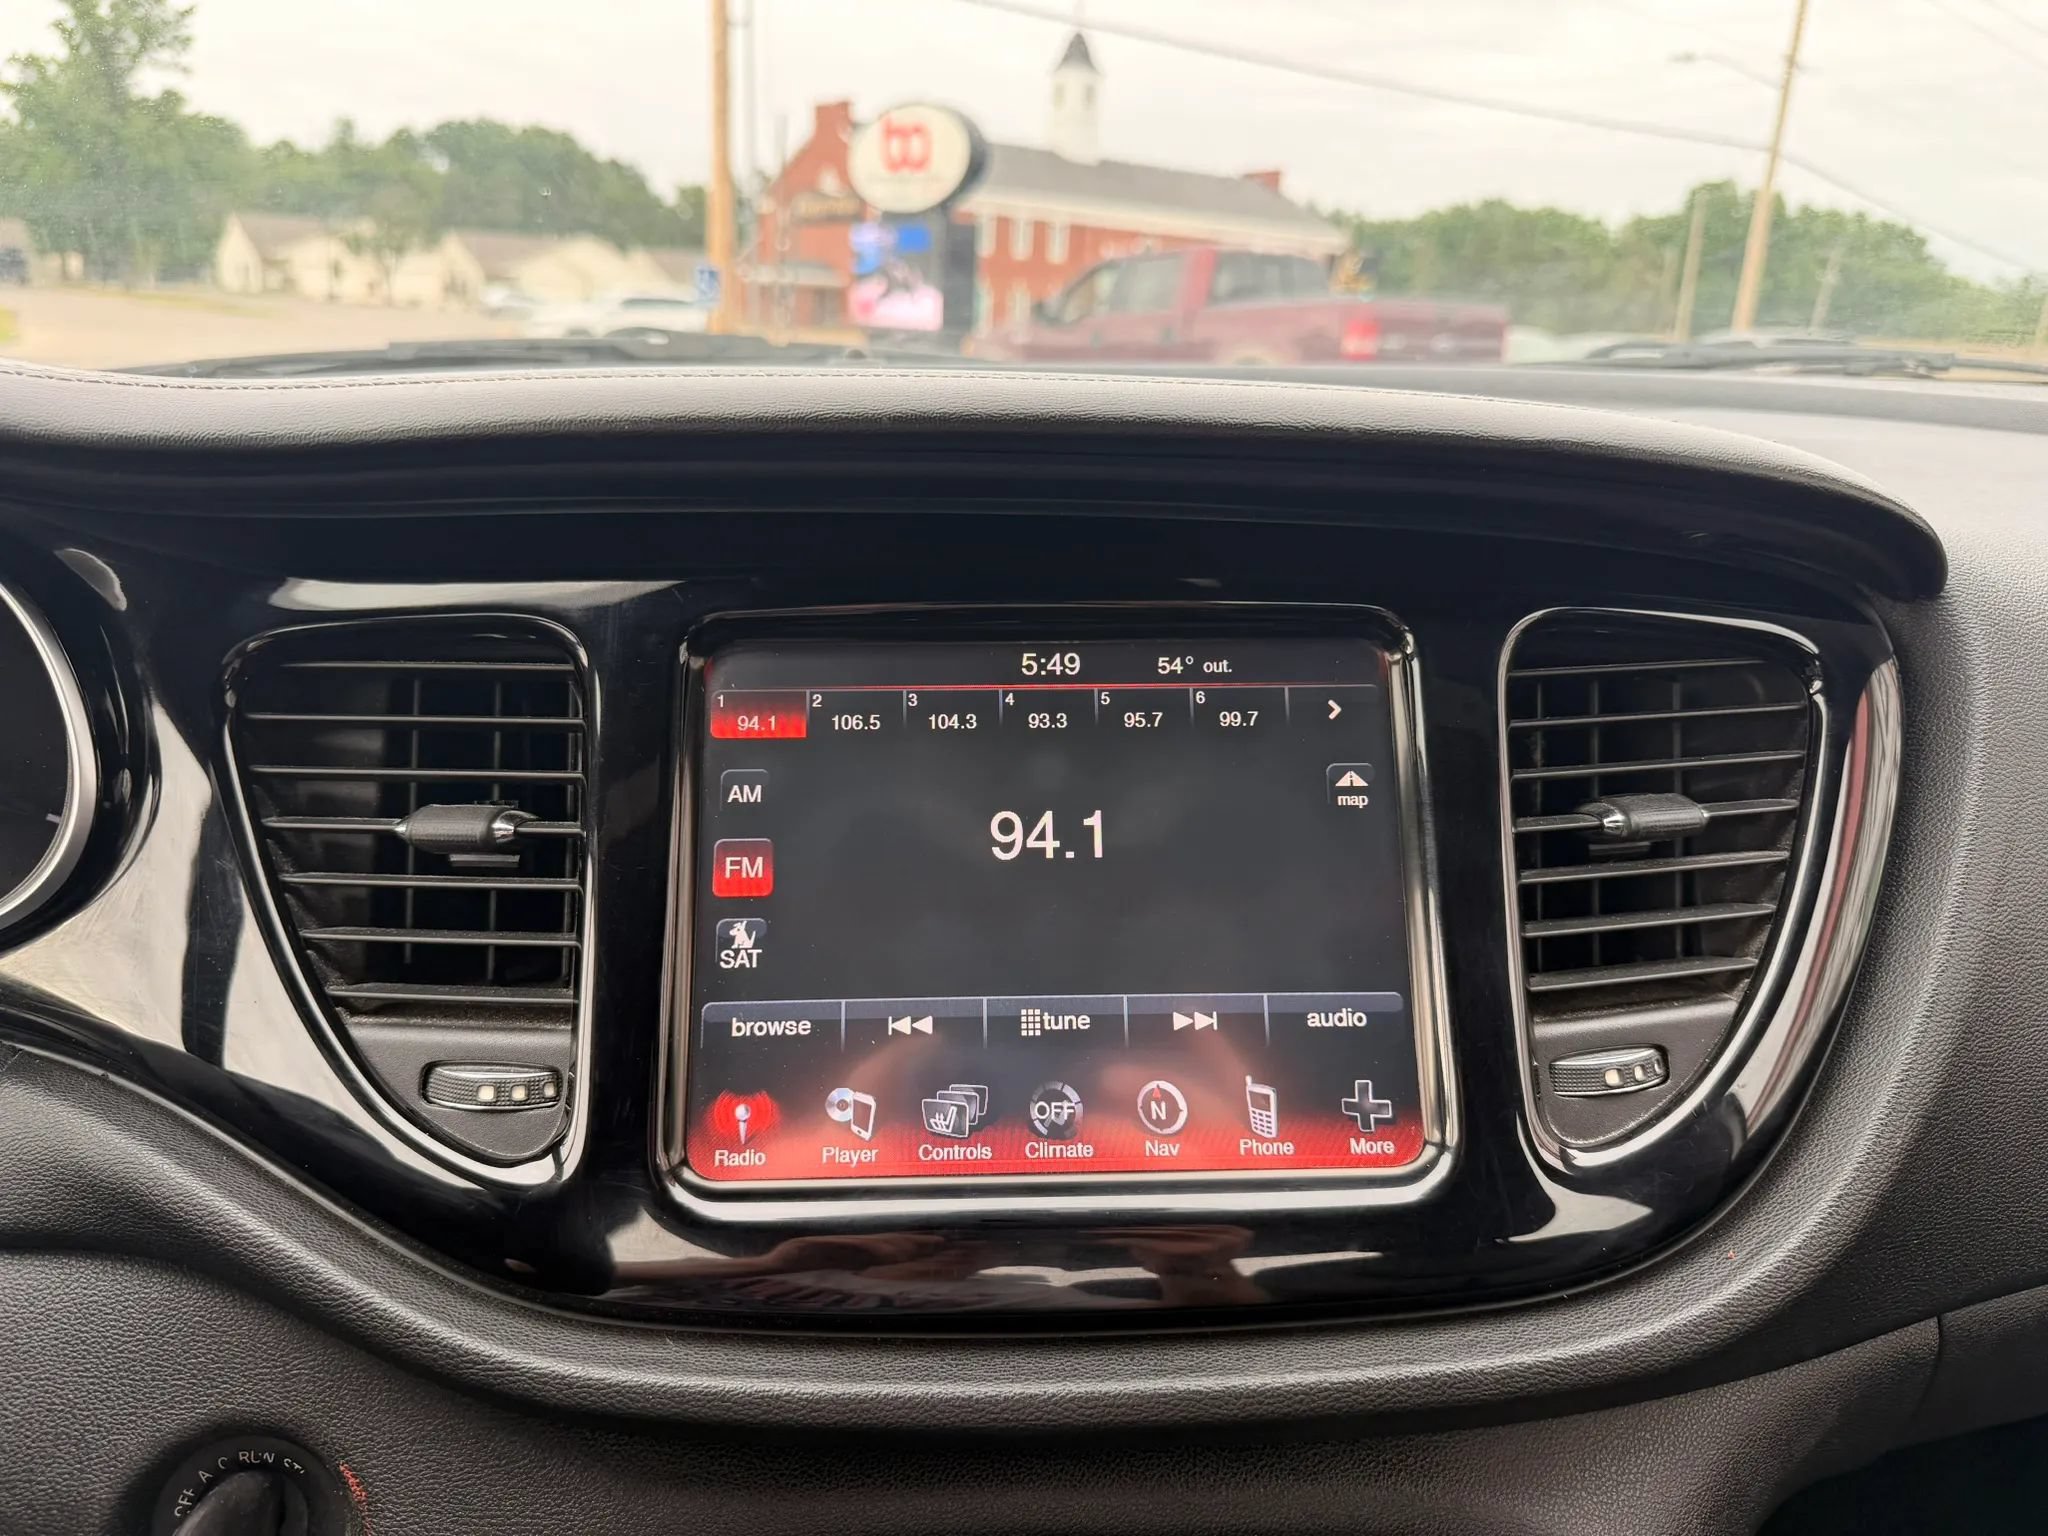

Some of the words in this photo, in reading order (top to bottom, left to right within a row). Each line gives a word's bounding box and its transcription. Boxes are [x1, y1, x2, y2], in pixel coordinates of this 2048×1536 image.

[1021, 652, 1081, 677] 5:49
[1157, 655, 1194, 675] 54°
[1203, 659, 1233, 673] out.
[717, 694, 724, 708] 1
[812, 693, 822, 708] 2
[908, 693, 918, 707] 3
[1004, 692, 1015, 706] 4
[1100, 691, 1111, 705] 5
[1195, 690, 1206, 704] 6
[737, 715, 776, 731] 94.1
[831, 714, 881, 731] 106.5
[928, 713, 977, 730] 104.3
[1028, 712, 1068, 729] 93.3
[1123, 711, 1163, 728] 95.7
[1219, 710, 1259, 727] 99.7
[727, 784, 762, 803] AM
[1337, 795, 1369, 809] map
[990, 809, 1103, 861] 94.1
[725, 856, 763, 878] FM
[719, 950, 763, 969] SAT
[1042, 1011, 1091, 1030] tune
[1307, 1007, 1367, 1027] audio
[731, 1017, 812, 1037] browse
[1034, 1101, 1074, 1120] OFF
[1150, 1100, 1167, 1120] N
[918, 1143, 993, 1161] Controls
[1025, 1141, 1094, 1159] Climate
[1145, 1140, 1180, 1156] Nav
[1239, 1138, 1295, 1155] Phone
[1349, 1137, 1395, 1155] More
[715, 1148, 766, 1167] Radio
[822, 1146, 879, 1167] Player
[238, 1450, 276, 1464] RUN
